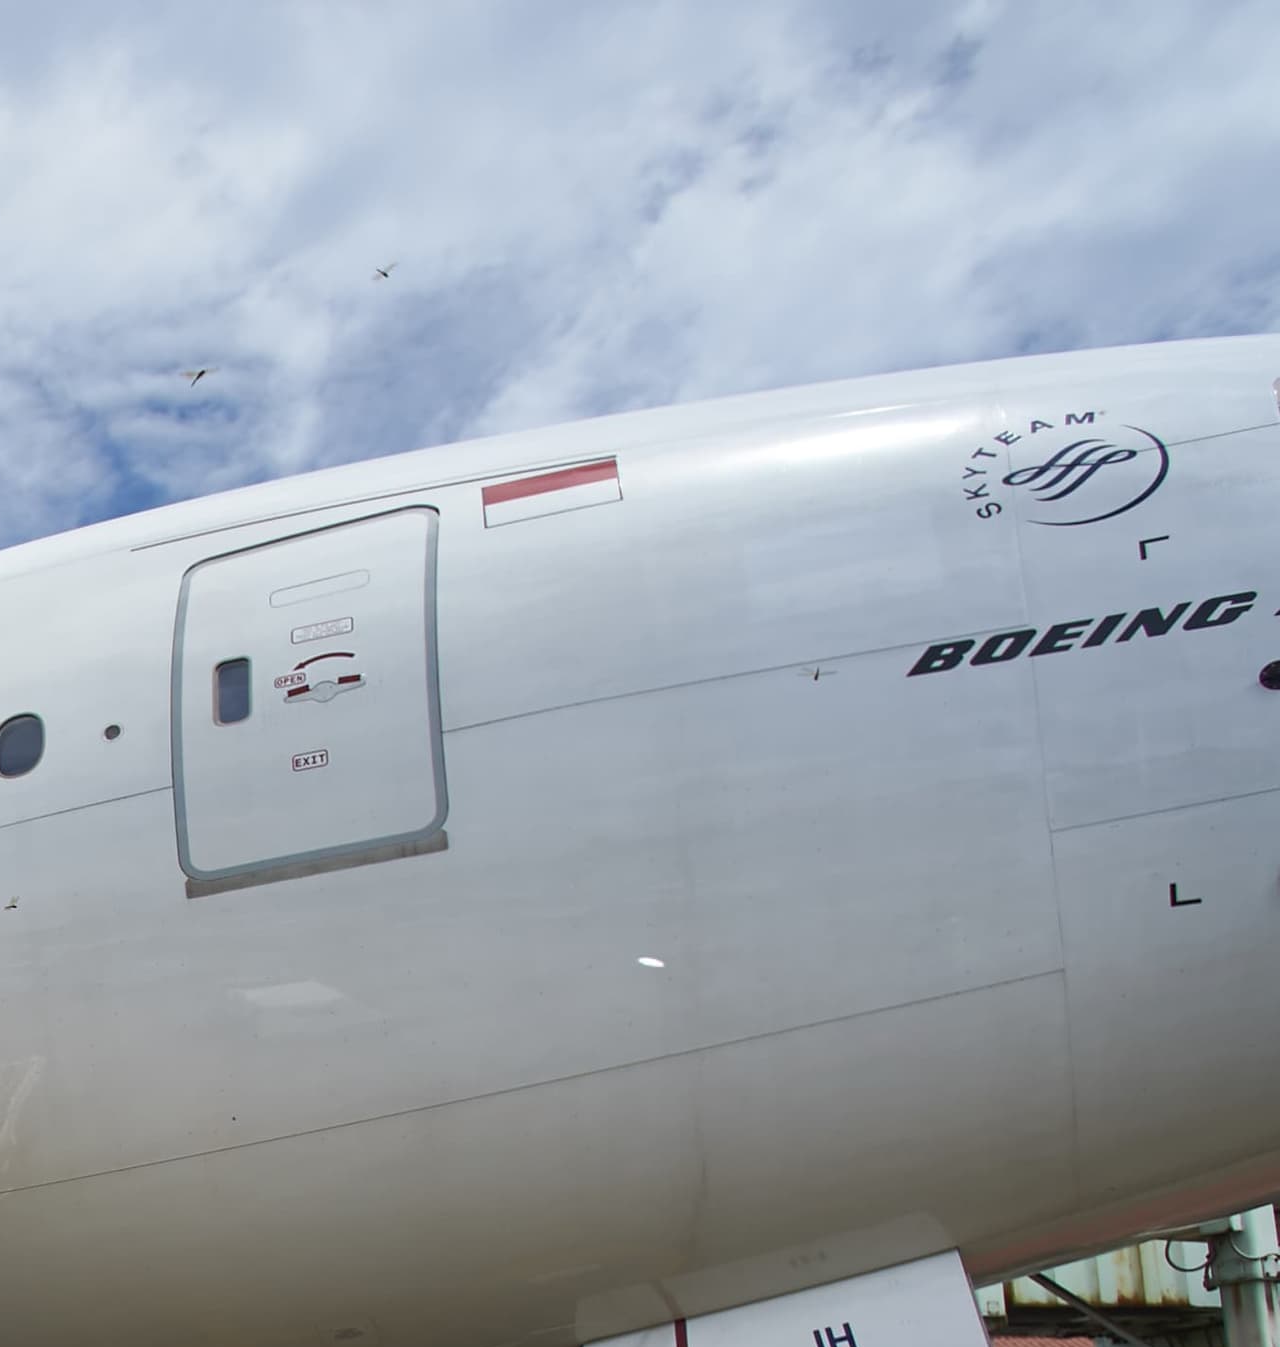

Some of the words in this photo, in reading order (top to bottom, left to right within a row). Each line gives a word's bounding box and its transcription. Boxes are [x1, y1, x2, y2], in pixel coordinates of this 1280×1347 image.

[962, 411, 1095, 519] SKYTEAM
[906, 591, 1257, 677] BOEING
[276, 674, 303, 687] OPEN
[295, 753, 325, 768] EXIT
